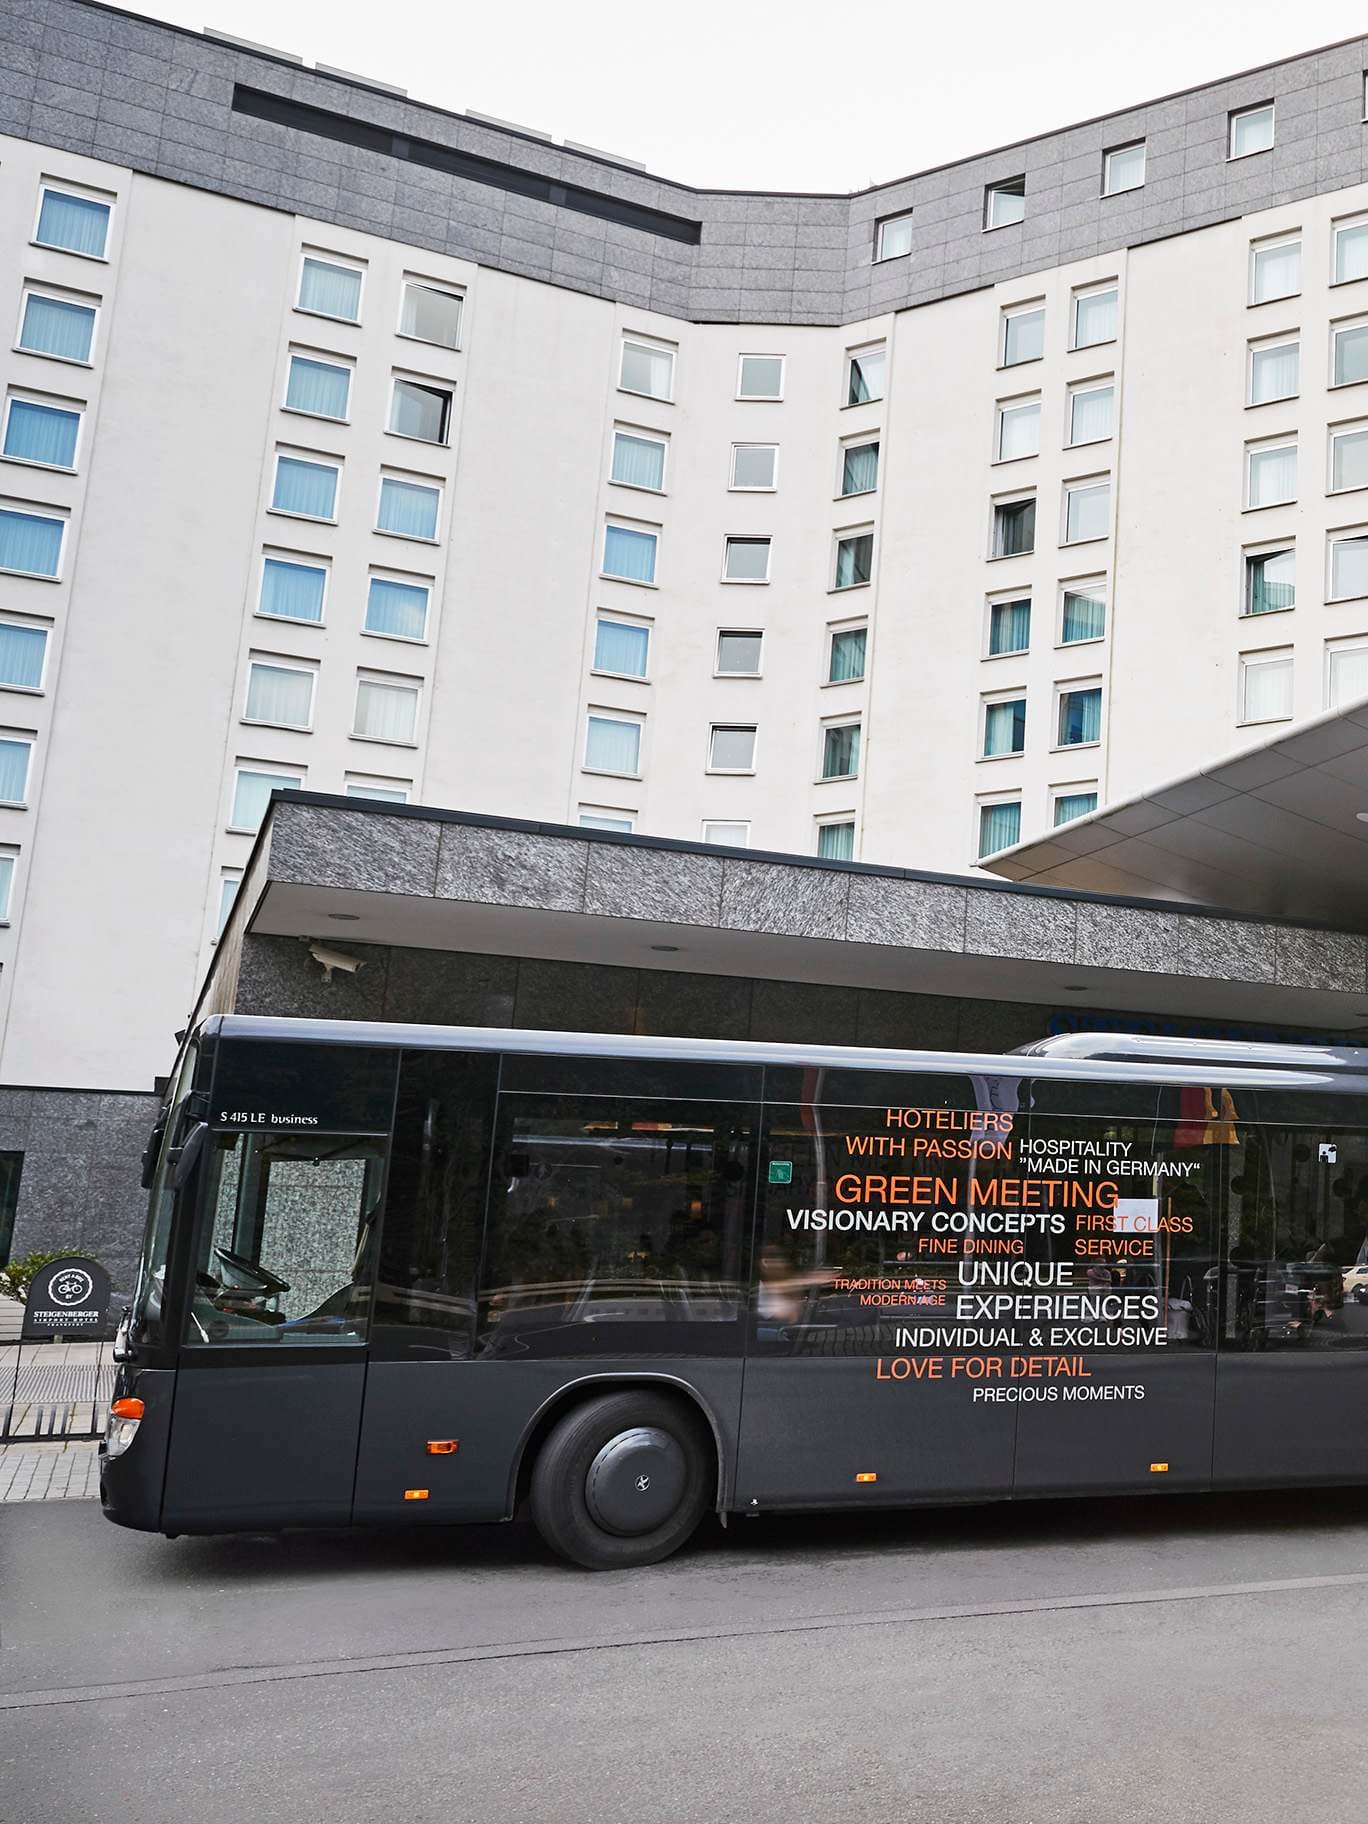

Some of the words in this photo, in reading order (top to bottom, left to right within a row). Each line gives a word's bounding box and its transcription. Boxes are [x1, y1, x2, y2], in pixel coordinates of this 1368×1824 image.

[220, 1111, 228, 1122] S
[229, 1112, 248, 1123] 415
[250, 1112, 266, 1123] LE
[271, 1113, 319, 1125] business
[886, 1108, 1014, 1132] HOTELIERS
[846, 1135, 906, 1157] WITH
[912, 1137, 1013, 1161] PASSION
[1020, 1138, 1133, 1158] HOSPITALITY
[1084, 1158, 1103, 1175] IN
[834, 1174, 958, 1206] GREEN
[970, 1177, 1120, 1210] MEETING
[786, 1209, 925, 1232] VISIONARY
[931, 1211, 1066, 1234] CONCEPTS
[1076, 1214, 1129, 1232] FIRST
[1133, 1215, 1194, 1233] CLASS
[918, 1238, 958, 1254] FINE
[963, 1238, 1024, 1255] DINING
[1074, 1239, 1154, 1256] SERVICE
[958, 1261, 1074, 1288] UNIQUE
[832, 1279, 901, 1290] TRADITION
[904, 1279, 947, 1291] MEETS
[860, 1294, 917, 1306] MODERN
[919, 1294, 946, 1306] AGE
[955, 1294, 1160, 1321] EXPERIENCES
[895, 1327, 1022, 1348] INDIVIDUAL
[1028, 1328, 1044, 1348] &
[1050, 1327, 1169, 1347] EXCLUSIVE
[876, 1357, 944, 1380] LOVE
[951, 1357, 1002, 1379] FOR
[1010, 1356, 1092, 1378] DETAIL
[973, 1386, 1058, 1402] PRECIOUS
[1063, 1385, 1145, 1401] MOMENTS
